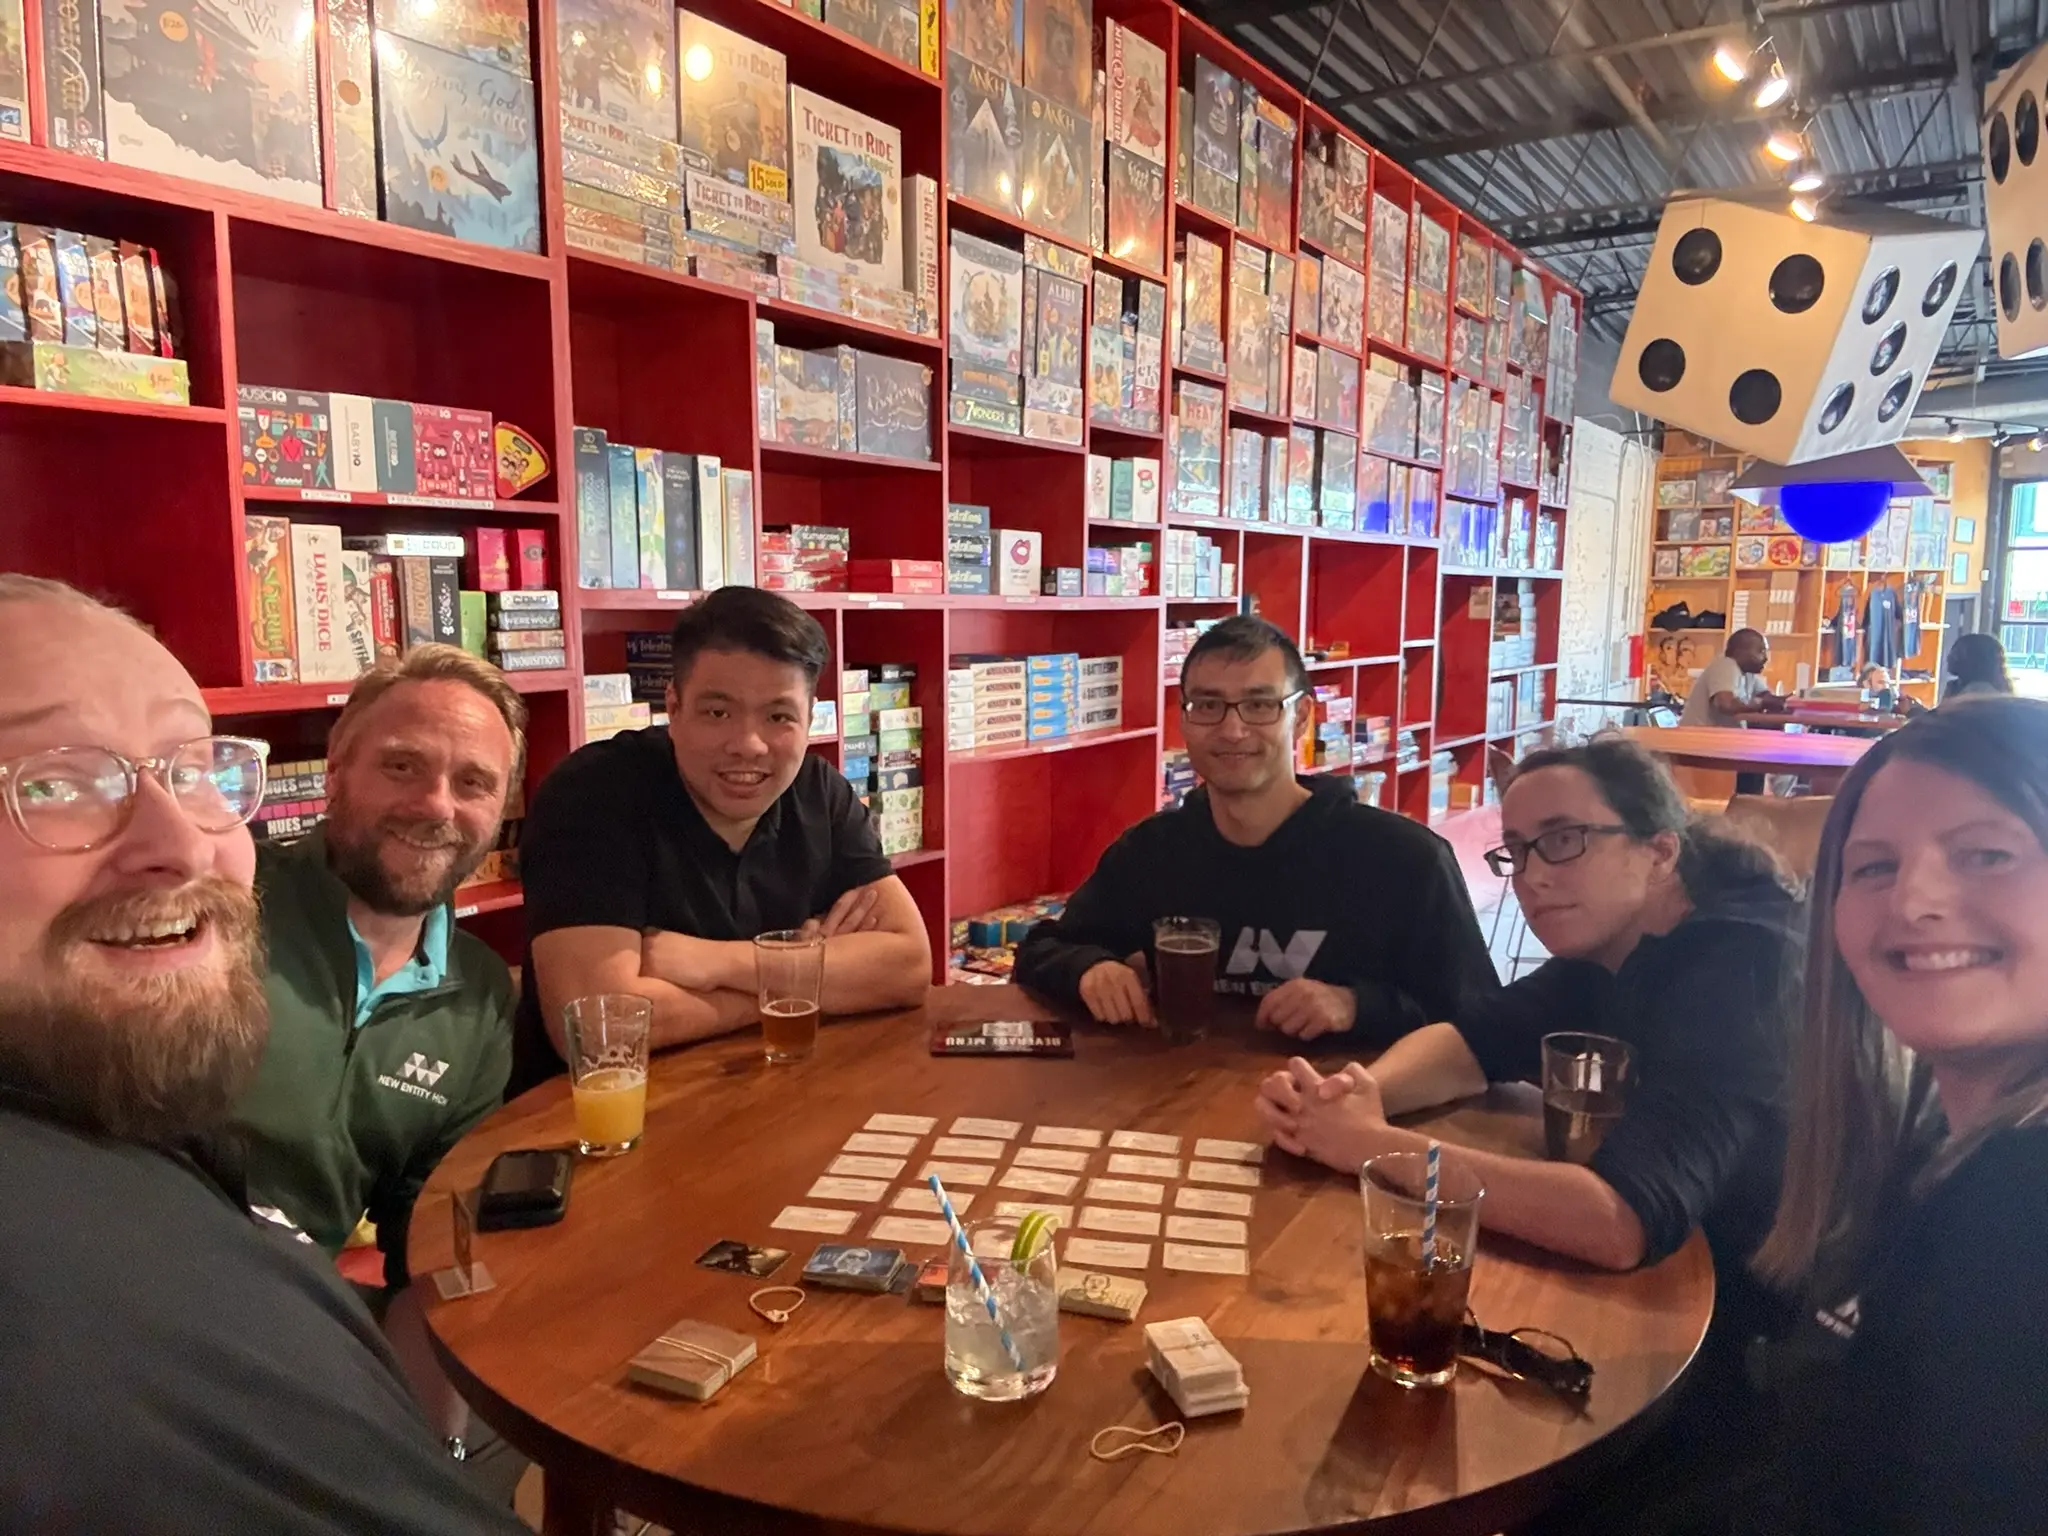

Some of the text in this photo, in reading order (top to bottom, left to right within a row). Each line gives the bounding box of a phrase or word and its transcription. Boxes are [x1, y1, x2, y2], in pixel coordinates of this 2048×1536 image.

[1043, 102, 1076, 135] ANKH
[803, 106, 894, 163] TICKET TO RIDE
[751, 163, 764, 192] 15
[694, 178, 732, 207] TICKET
[745, 193, 768, 218] RIDE
[926, 262, 937, 298] RIDE
[966, 400, 975, 421] 7
[316, 608, 332, 652] DICE
[267, 817, 301, 835] HUES
[945, 1037, 986, 1046] MENU
[378, 1074, 400, 1089] NEW
[400, 1081, 432, 1099] ENTITY
